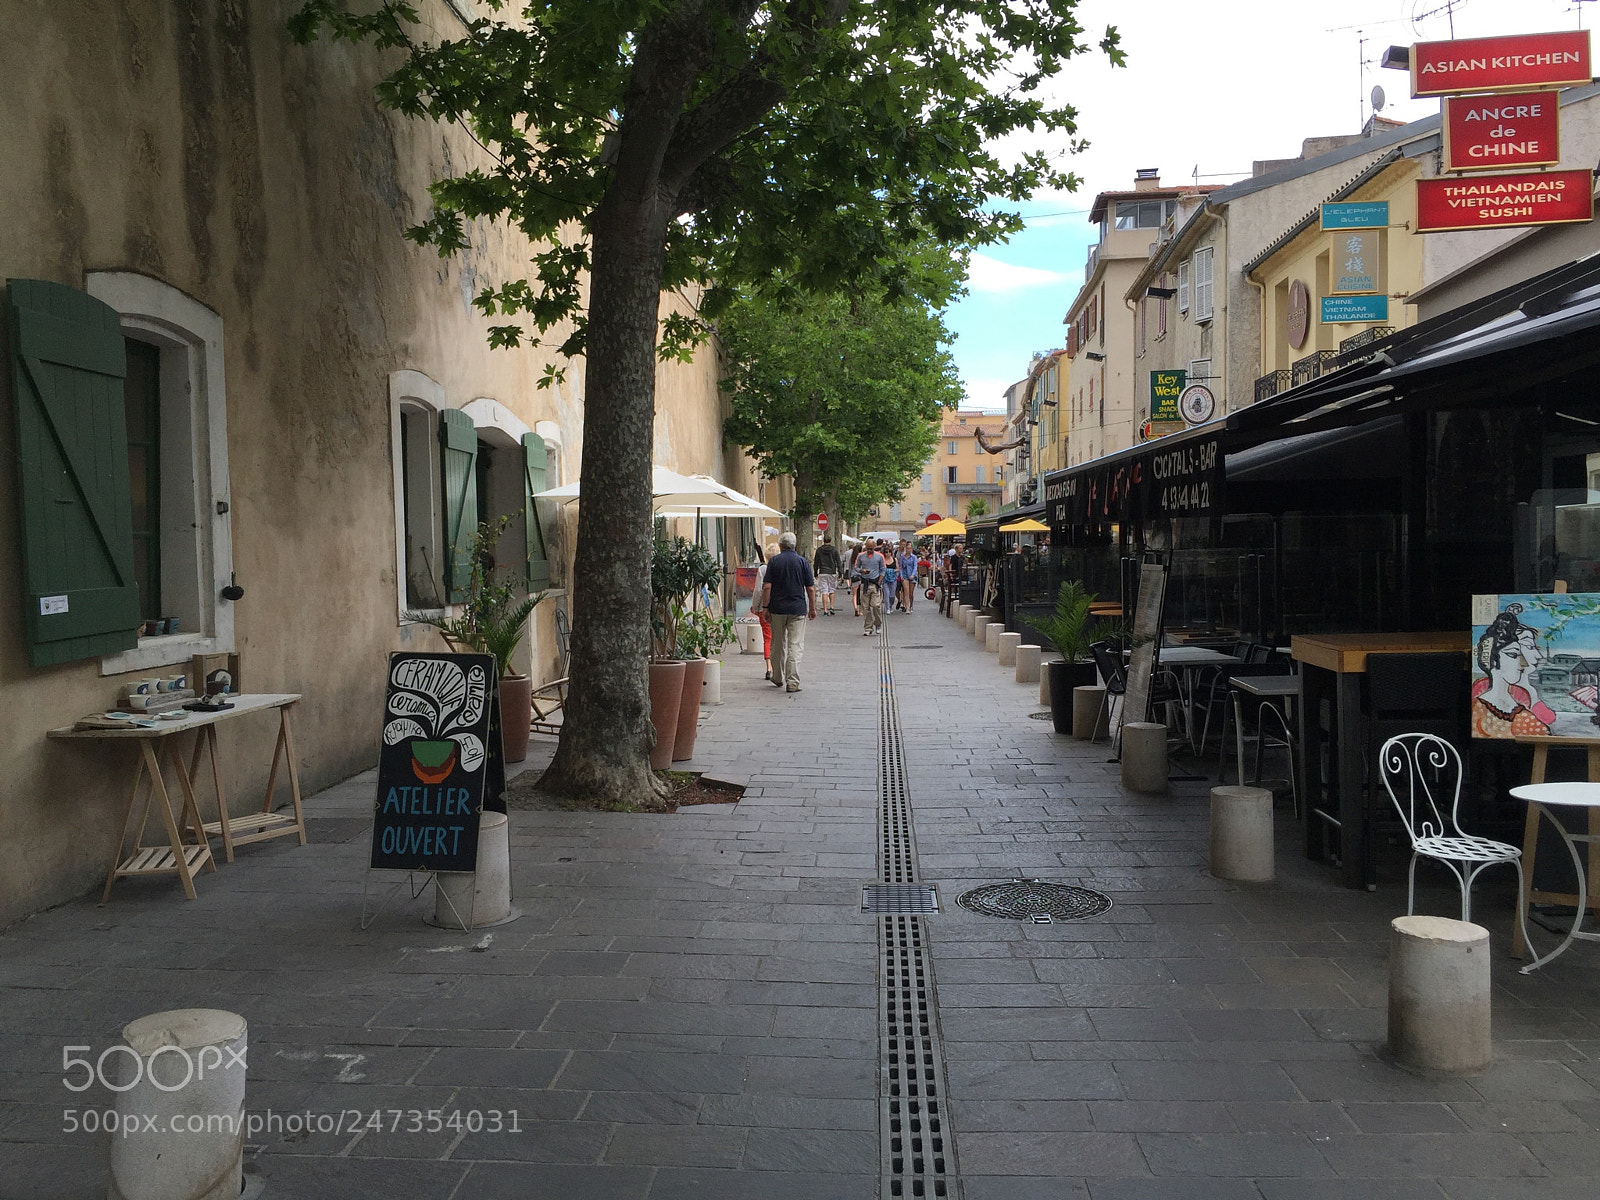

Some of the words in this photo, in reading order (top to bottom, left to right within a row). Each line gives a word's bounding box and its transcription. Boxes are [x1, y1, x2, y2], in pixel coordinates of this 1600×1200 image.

[1421, 58, 1486, 74] ASIAN
[1492, 51, 1580, 69] KITCHEN
[1464, 104, 1542, 122] ANCRE
[1489, 124, 1516, 138] de
[1468, 140, 1539, 157] CHINE
[1444, 180, 1566, 196] THAILANDAIS
[1447, 193, 1562, 208] VIETNAMIEN
[1478, 206, 1533, 219] SUSHI
[1340, 275, 1372, 283] ASIAN
[1325, 312, 1376, 320] THAILANDE
[1157, 373, 1178, 387] Key
[1153, 386, 1181, 397] West
[381, 825, 464, 855] OUVERT
